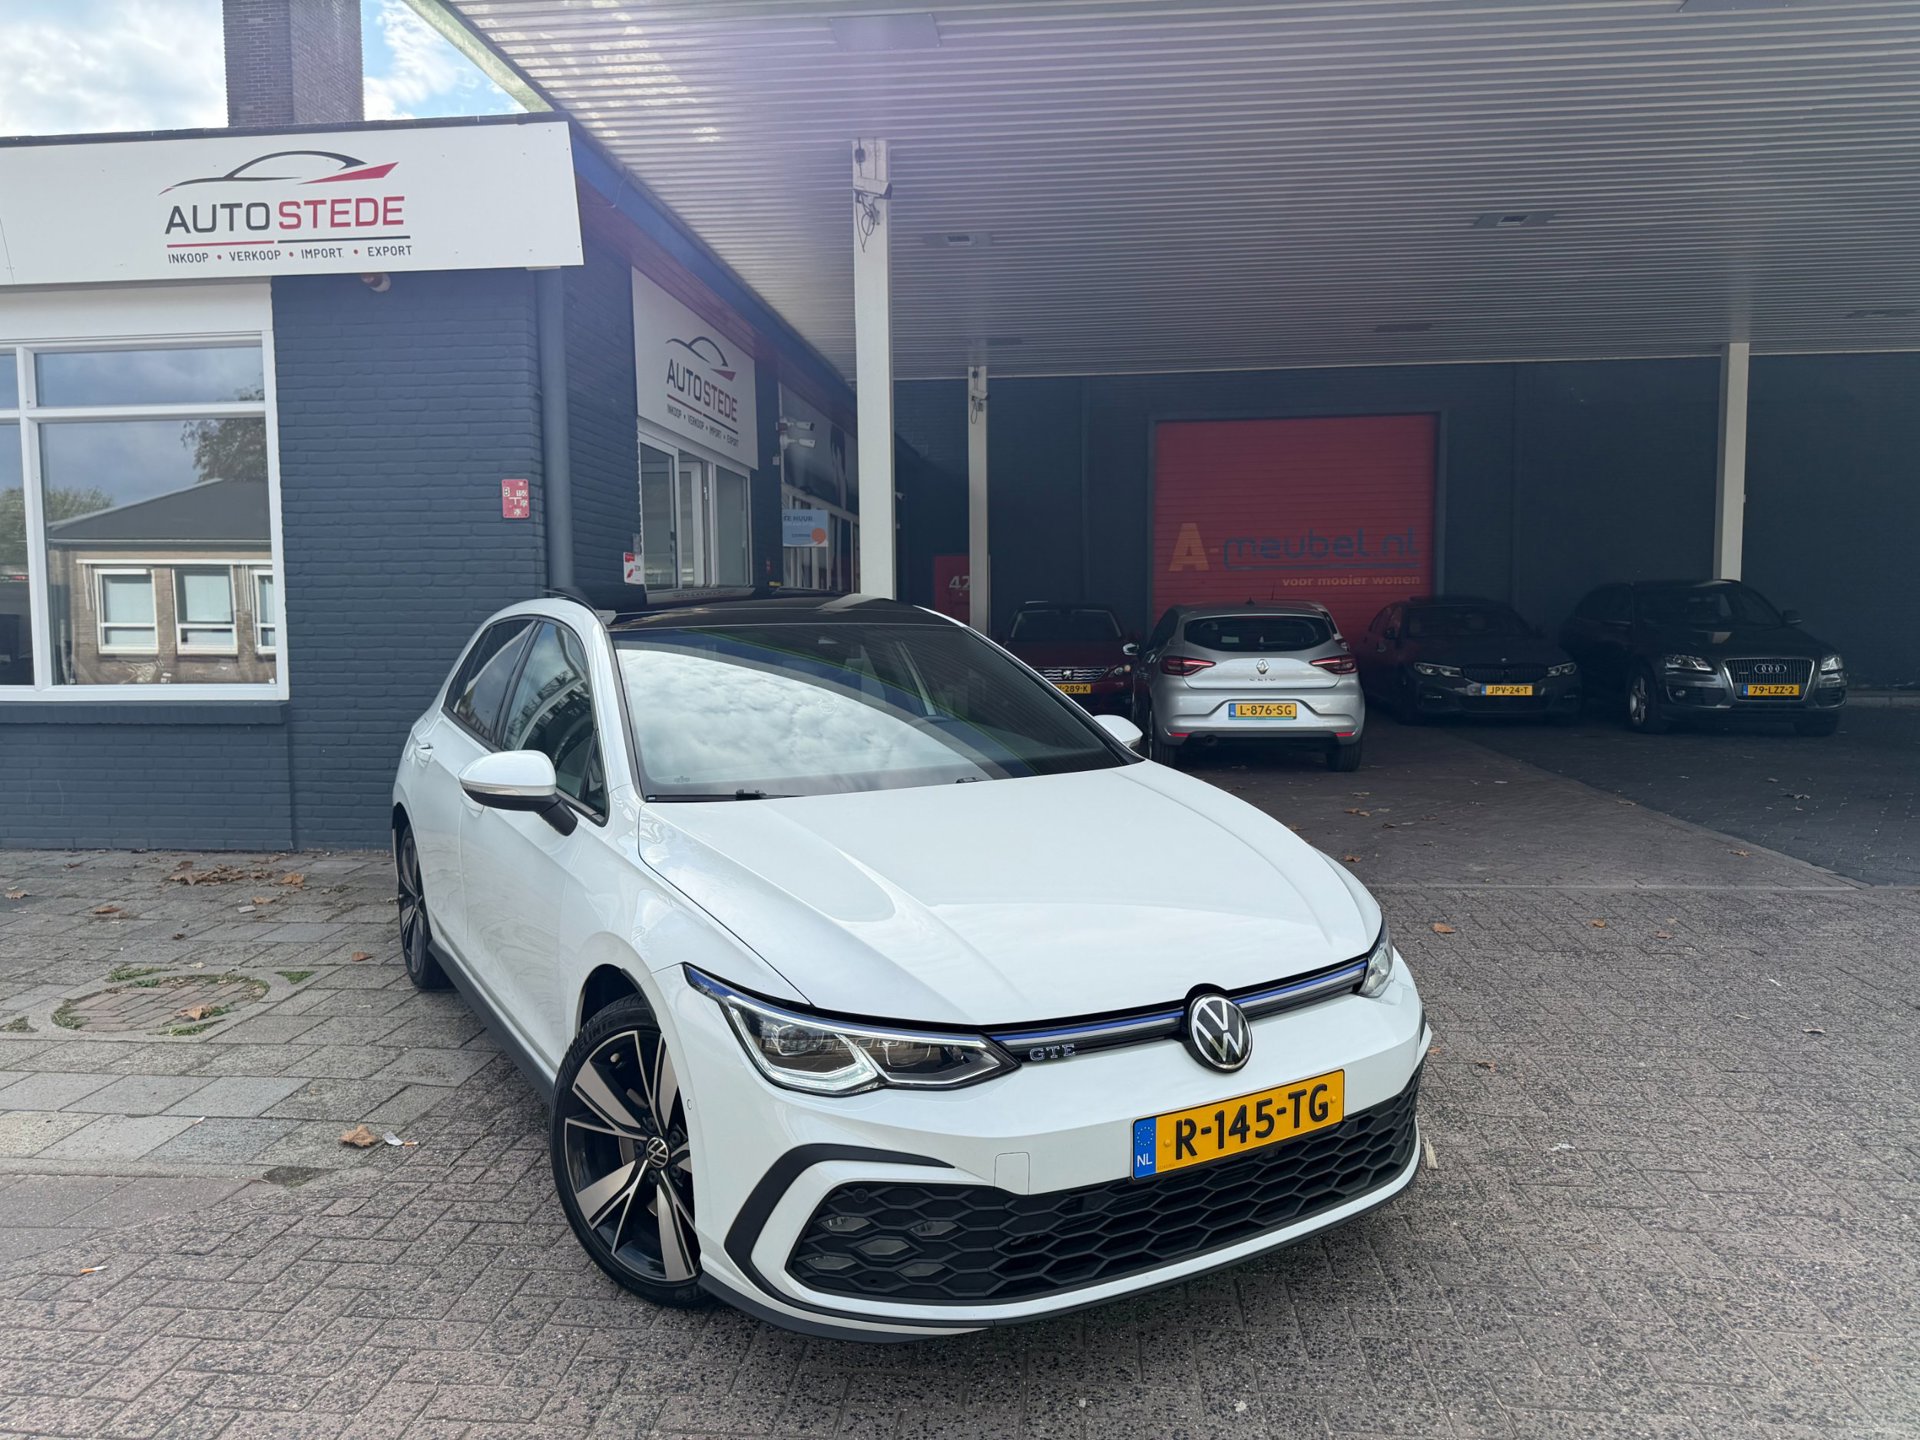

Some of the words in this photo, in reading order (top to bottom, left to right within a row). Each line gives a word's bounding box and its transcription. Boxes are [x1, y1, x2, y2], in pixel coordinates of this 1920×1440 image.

[168, 252, 209, 264] INKOOP
[229, 250, 282, 262] VERKOOP
[301, 248, 343, 259] IMPORT
[367, 245, 412, 257] EXPORT
[1282, 577, 1313, 587] voor
[1318, 575, 1368, 585] mooier
[1372, 575, 1420, 585] wonen
[1490, 686, 1528, 695] JPV-24-T
[1753, 686, 1794, 694] 79-LZZ-2
[1240, 705, 1292, 715] L-876-SG
[1030, 1043, 1076, 1061] GTE
[1175, 1083, 1329, 1160] R-145-TG
[1136, 1153, 1153, 1168] NL
